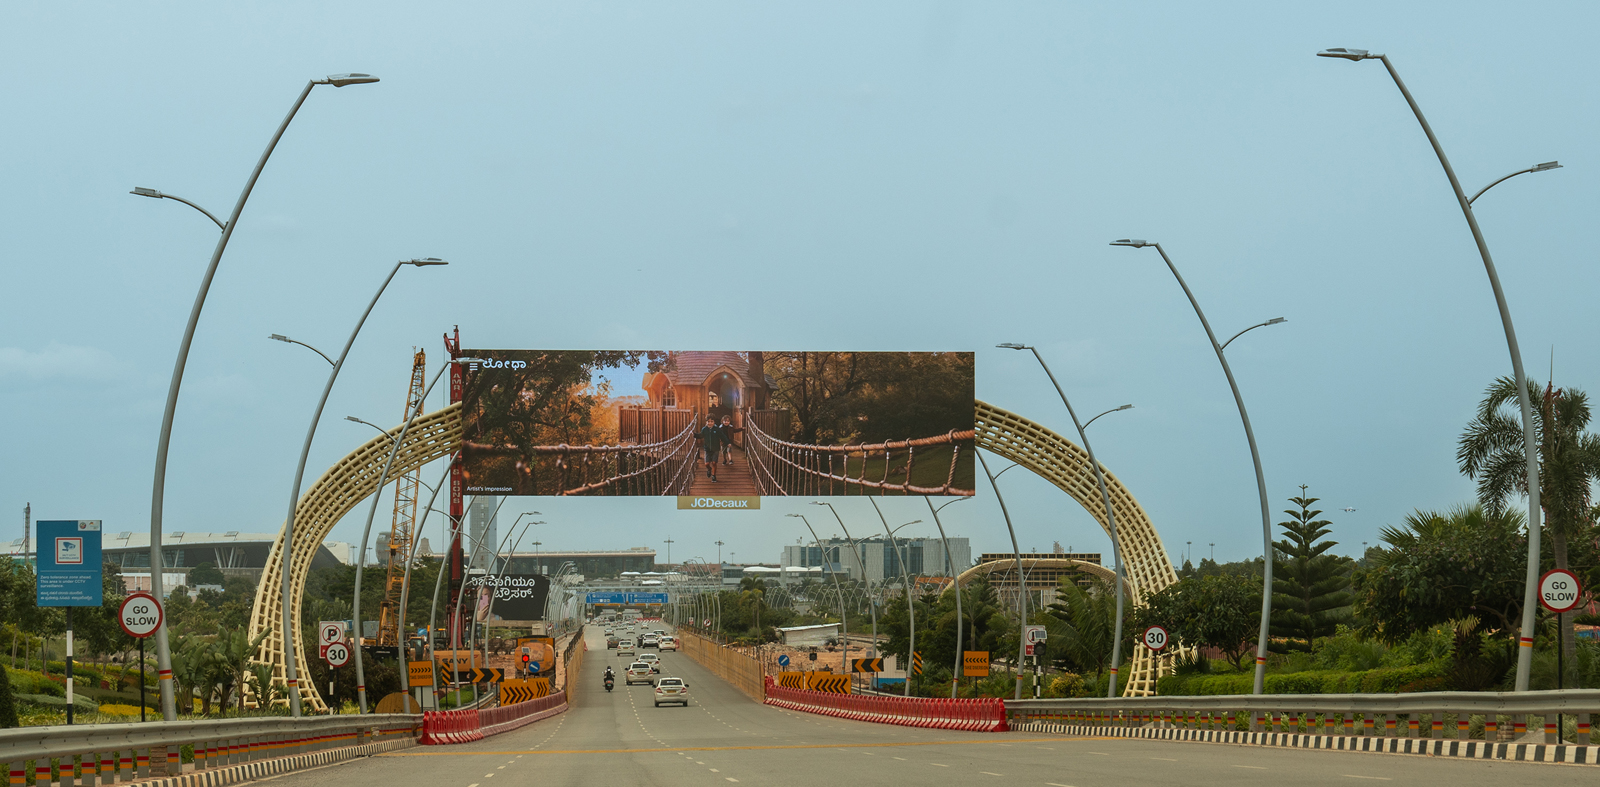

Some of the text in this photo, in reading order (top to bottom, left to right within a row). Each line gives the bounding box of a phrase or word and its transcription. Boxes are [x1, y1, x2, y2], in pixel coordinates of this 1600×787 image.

[452, 480, 461, 504] SONS
[690, 497, 748, 508] JCDecaux
[1552, 581, 1567, 590] GO
[1545, 592, 1575, 601] SLOW
[133, 606, 149, 614] GO
[126, 617, 156, 626] SLOW
[328, 628, 338, 641] P
[1148, 632, 1164, 644] 30
[329, 649, 346, 661] 30
